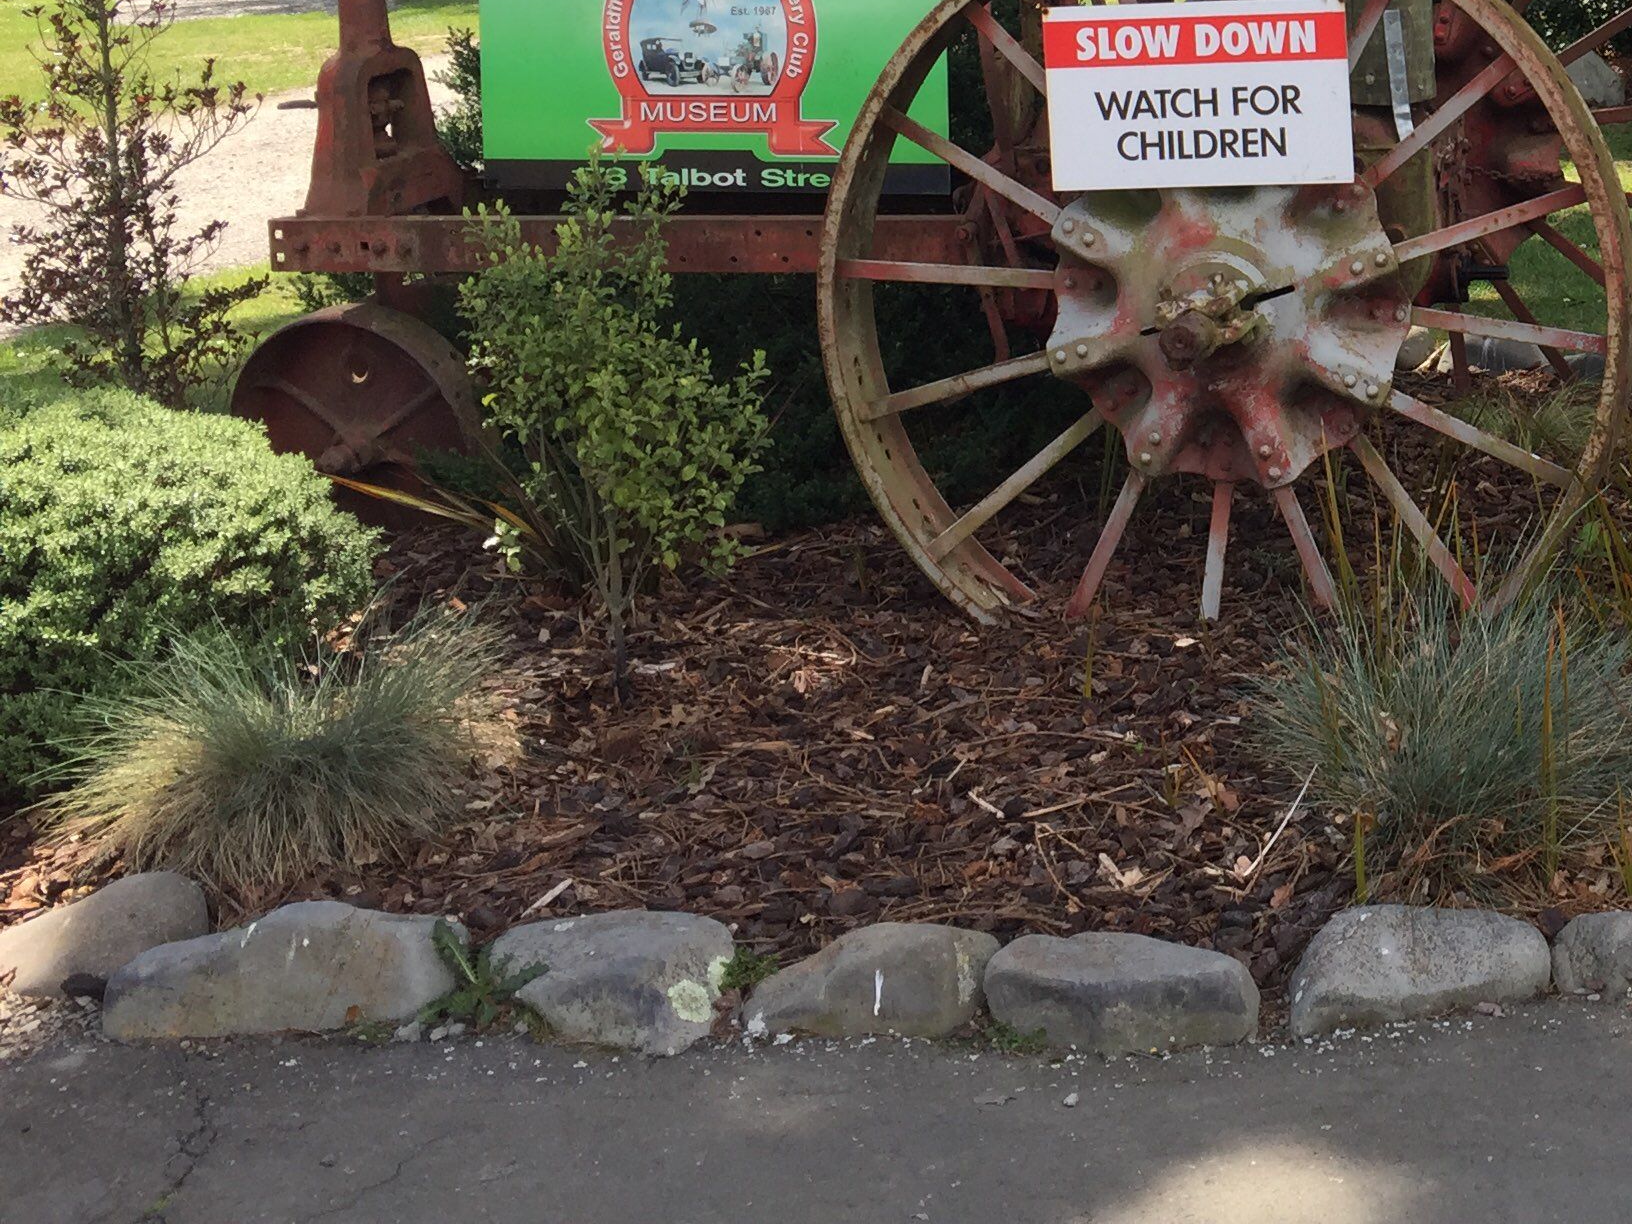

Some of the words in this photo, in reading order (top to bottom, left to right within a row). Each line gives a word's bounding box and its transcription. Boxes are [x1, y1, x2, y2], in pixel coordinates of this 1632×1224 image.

[785, 32, 810, 79] Club
[1075, 24, 1181, 62] SLOW
[1194, 19, 1317, 57] DOWN
[640, 101, 778, 123] MUSEUM
[1094, 87, 1219, 121] WATCH
[1232, 84, 1303, 117] FOR
[1117, 127, 1288, 162] CHILDREN
[760, 167, 832, 188] Stre
